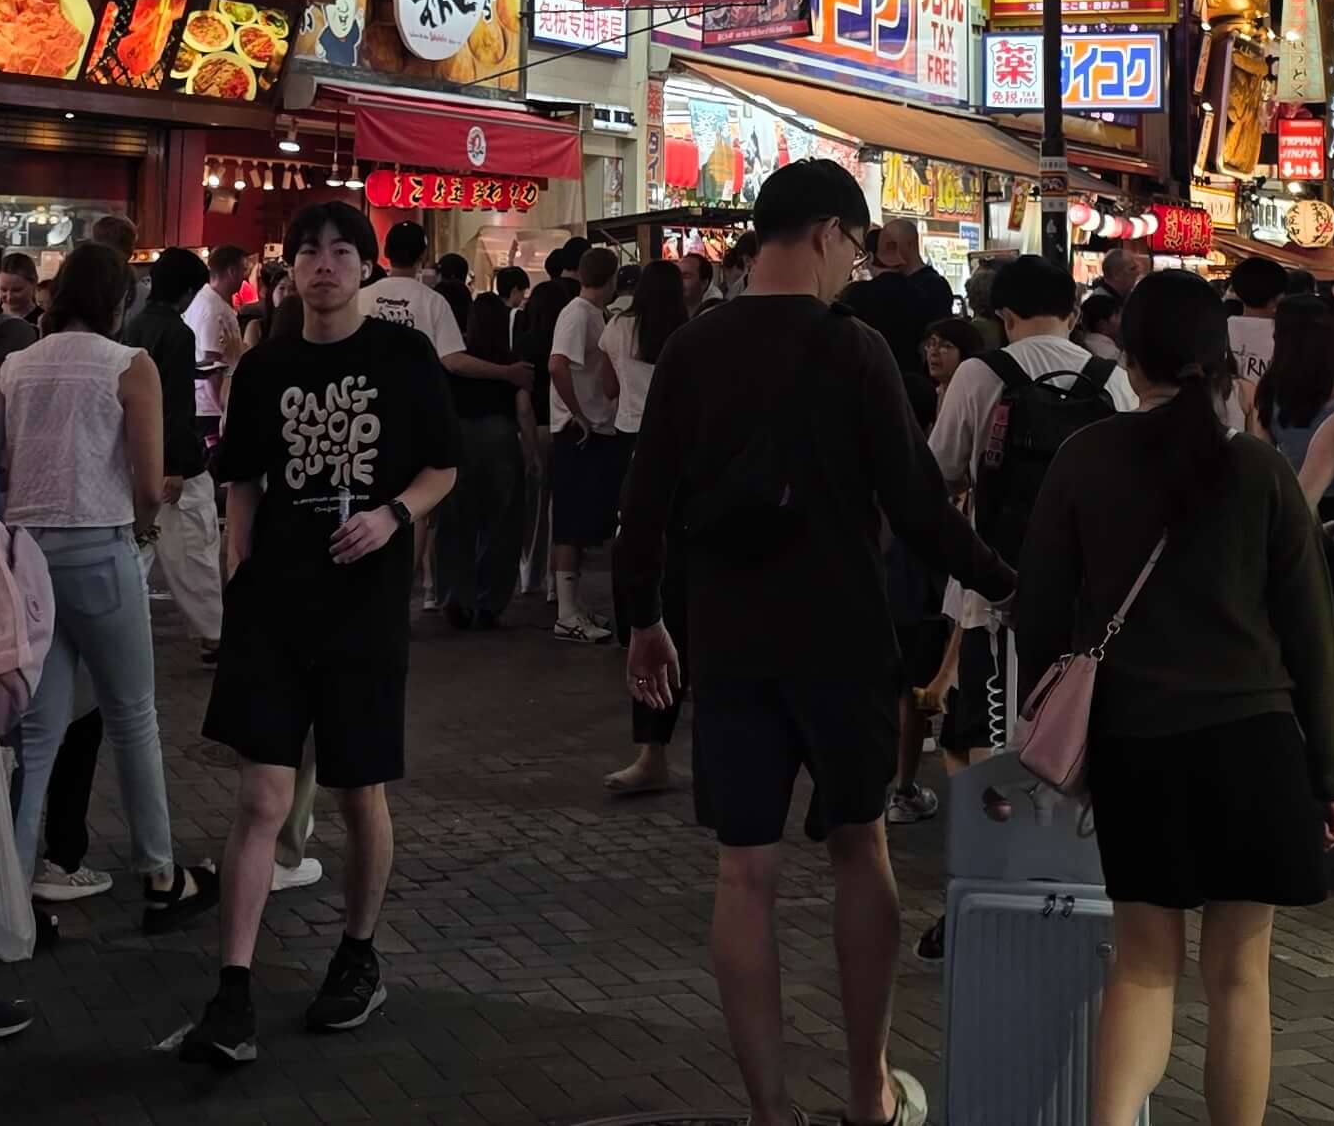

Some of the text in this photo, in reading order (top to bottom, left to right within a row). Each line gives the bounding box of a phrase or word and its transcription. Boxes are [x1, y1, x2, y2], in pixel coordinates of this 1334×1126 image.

[930, 20, 955, 55] TAX
[926, 53, 959, 88] FREE
[995, 39, 1035, 86] 薬
[992, 90, 1018, 105] 免税
[1279, 135, 1323, 147] TEPPAN
[281, 410, 381, 456] STOP
[284, 448, 379, 490] CUTIE
